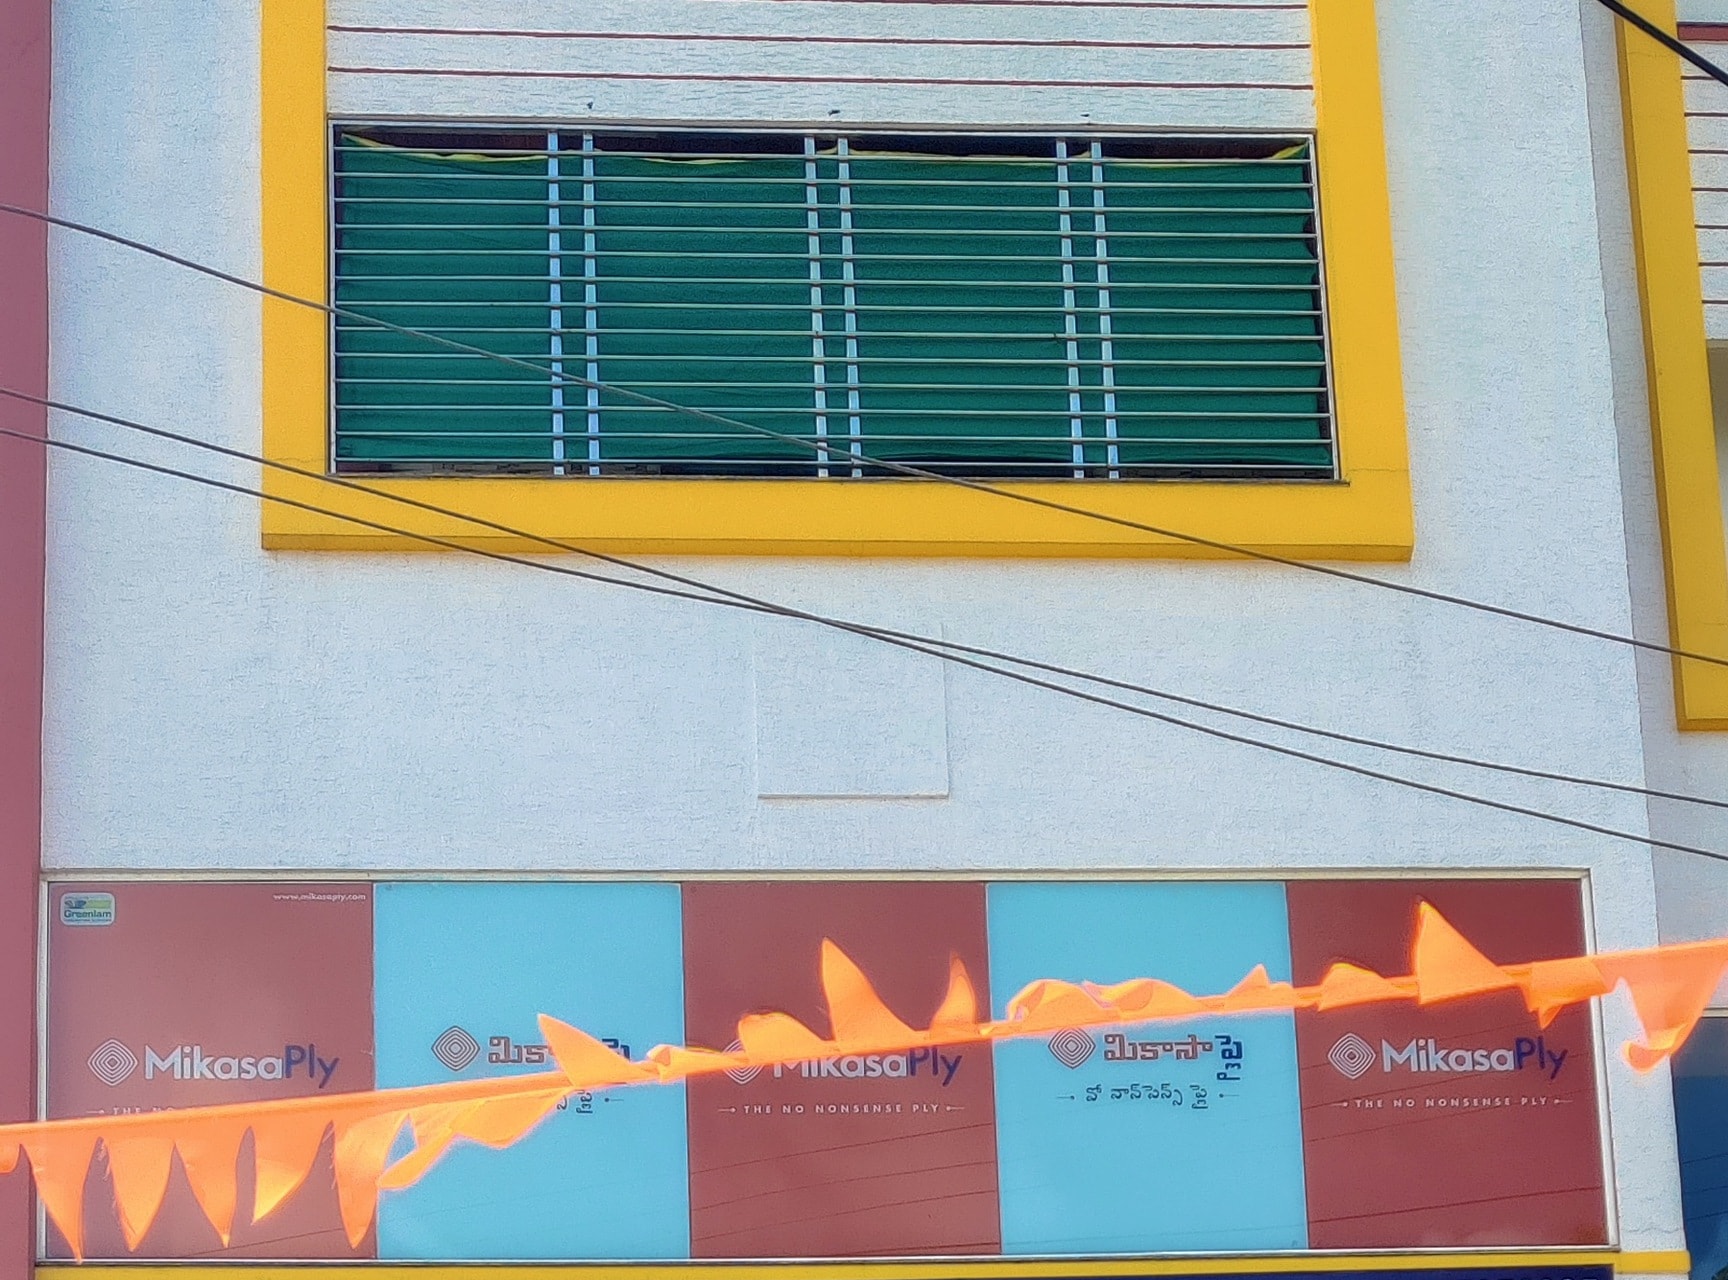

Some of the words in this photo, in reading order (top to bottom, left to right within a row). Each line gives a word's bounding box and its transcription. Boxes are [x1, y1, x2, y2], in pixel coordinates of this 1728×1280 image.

[144, 1043, 339, 1088] MikasaPly
[1381, 1036, 1568, 1080] MikasaPly
[743, 1104, 772, 1114] THE
[782, 1104, 804, 1114] NO
[815, 1103, 903, 1113] NONSENSE
[912, 1103, 939, 1113] PLY
[1354, 1099, 1383, 1109] THE
[1393, 1099, 1415, 1108] NO
[1425, 1097, 1511, 1107] NONSENSE
[1521, 1097, 1548, 1106] PLY
